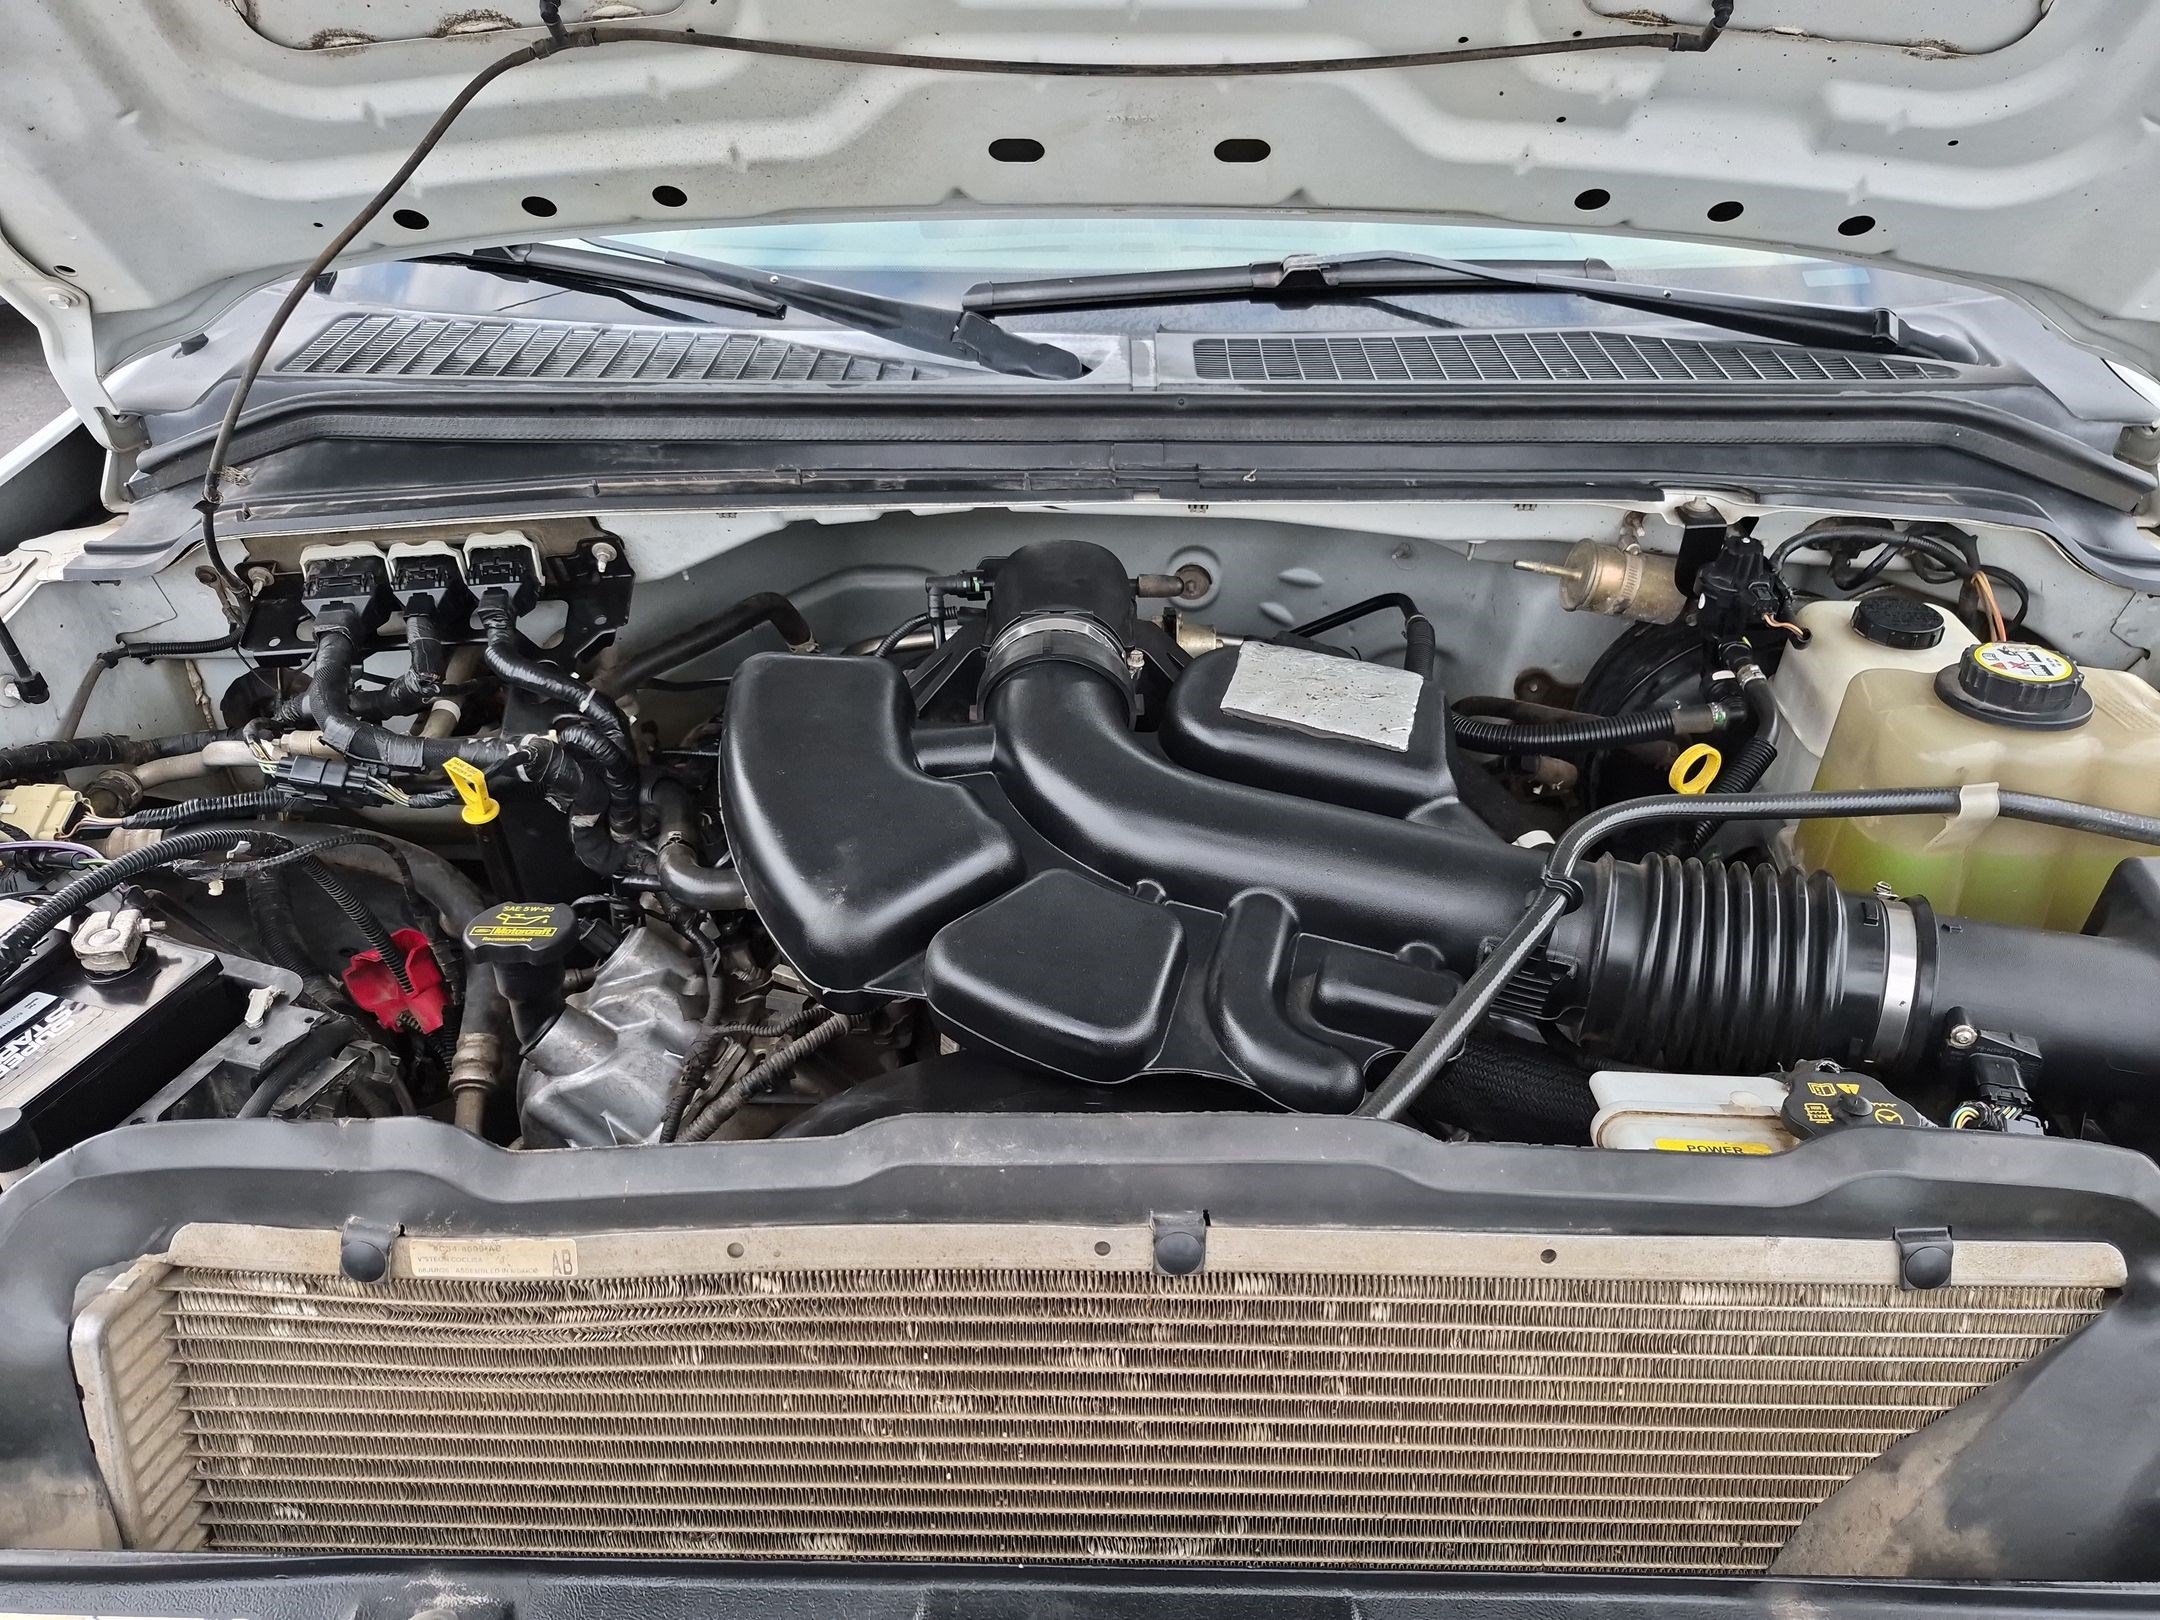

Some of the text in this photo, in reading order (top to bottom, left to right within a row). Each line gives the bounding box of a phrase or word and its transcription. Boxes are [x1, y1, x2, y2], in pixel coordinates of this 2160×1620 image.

[523, 905, 555, 913] 5W-20
[494, 927, 551, 936] Motorcraft
[1686, 1144, 1744, 1154] POWER
[552, 1248, 573, 1276] AB
